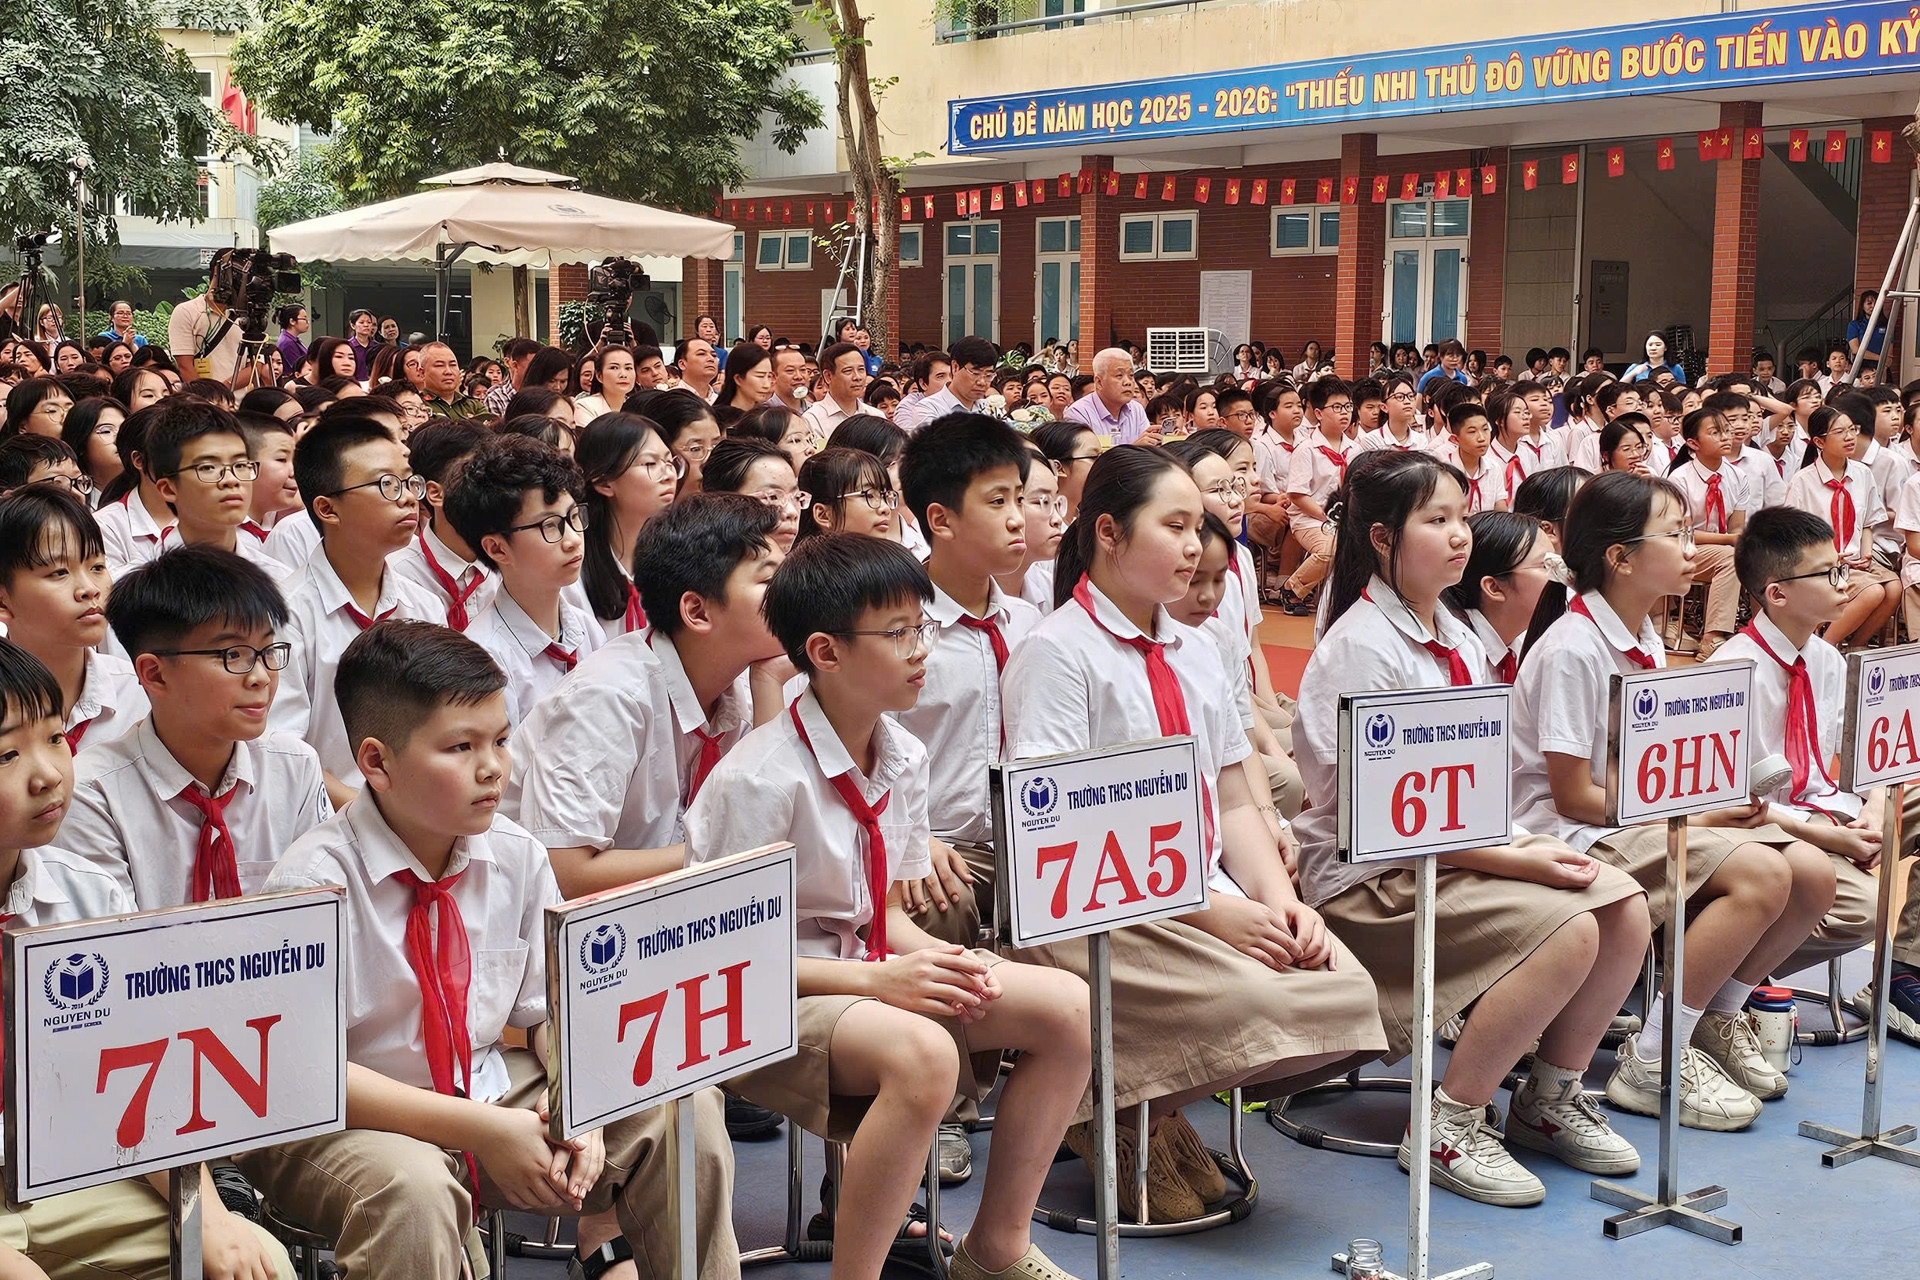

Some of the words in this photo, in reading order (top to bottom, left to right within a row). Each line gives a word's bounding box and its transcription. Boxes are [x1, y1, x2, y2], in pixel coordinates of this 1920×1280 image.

[970, 105, 1007, 141] CHỦ
[1012, 101, 1037, 137] ĐỀ
[1043, 101, 1086, 134] NĂM
[1092, 99, 1133, 134] HỌC
[1139, 95, 1192, 124] 2025
[1214, 85, 1278, 118] 2026:
[1285, 66, 1365, 110] "THIẾU
[1373, 69, 1417, 103] NHI
[1424, 54, 1477, 98] THỦ
[1484, 51, 1524, 93] ĐÔ
[1532, 46, 1611, 89] VỮNG
[1620, 33, 1706, 80] BƯỚC
[1715, 20, 1788, 71] TIẾN
[1797, 18, 1868, 63] VÀO
[1878, 7, 1920, 56] KỶ
[1402, 723, 1434, 745] TRƯỜNG
[1436, 724, 1456, 742] THCS
[1458, 716, 1488, 740] NGUYỄN
[1491, 720, 1502, 737] DU
[1664, 697, 1690, 717] TRƯỜNG
[1692, 696, 1708, 713] THCS
[1735, 691, 1744, 706] DU
[1067, 784, 1106, 810] TRƯỜNG
[1108, 782, 1132, 803] THCS
[1135, 769, 1173, 799] NGUYỄN
[1175, 772, 1187, 790] DU
[1637, 729, 1741, 804] 6HN
[1391, 763, 1475, 837] 6T
[1036, 820, 1188, 919] 7A5
[637, 925, 684, 960] TRƯỜNG
[687, 916, 716, 944] THCS
[720, 896, 764, 935] NGUYỄN
[767, 896, 781, 920] DU
[125, 962, 190, 1000] TRƯỜNG
[195, 957, 235, 988] THCS
[240, 939, 301, 981] NGUYỄN
[306, 942, 325, 970] DU
[580, 973, 614, 990] NGUYEN
[616, 968, 628, 979] DU
[43, 1011, 91, 1027] NGUYEN
[95, 1007, 111, 1019] DU
[617, 960, 751, 1087] 7H
[96, 1014, 281, 1148] 7N
